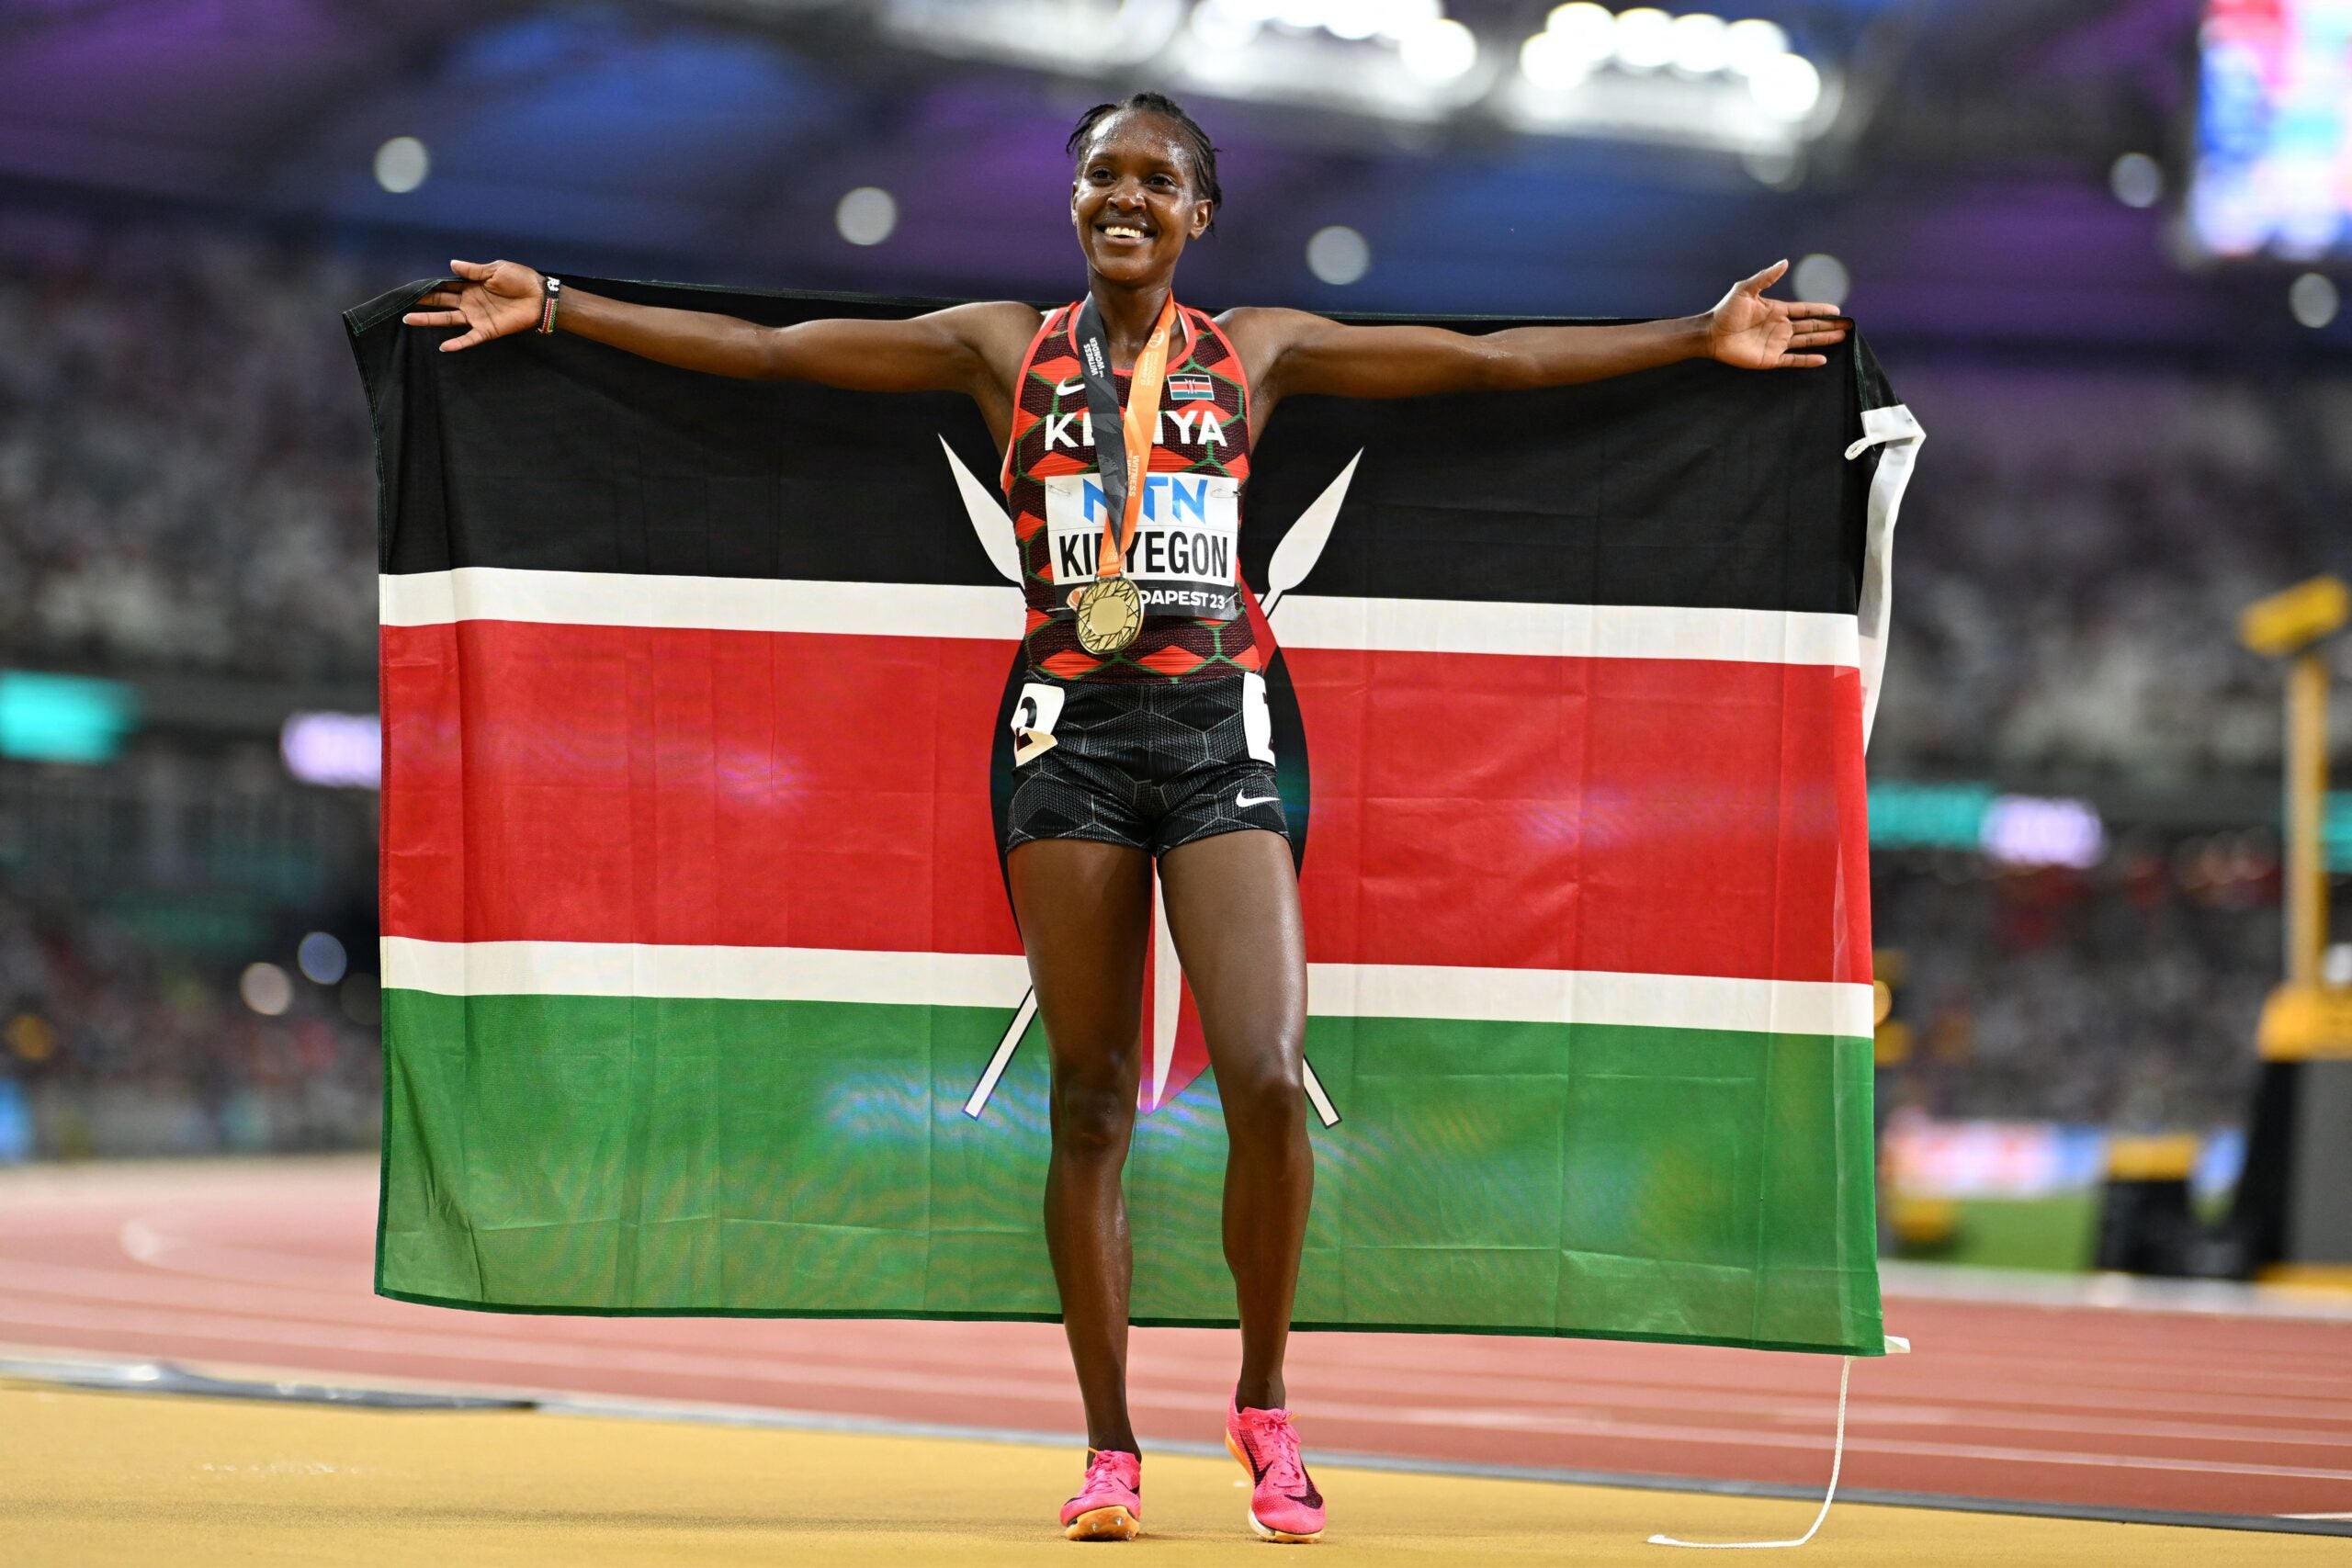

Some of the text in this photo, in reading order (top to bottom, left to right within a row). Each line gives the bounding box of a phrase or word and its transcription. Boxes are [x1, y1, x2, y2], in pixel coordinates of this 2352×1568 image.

[1083, 344, 1099, 377] WITNESS
[1089, 337, 1105, 369] WONDER
[1128, 455, 1140, 498] WITNESS
